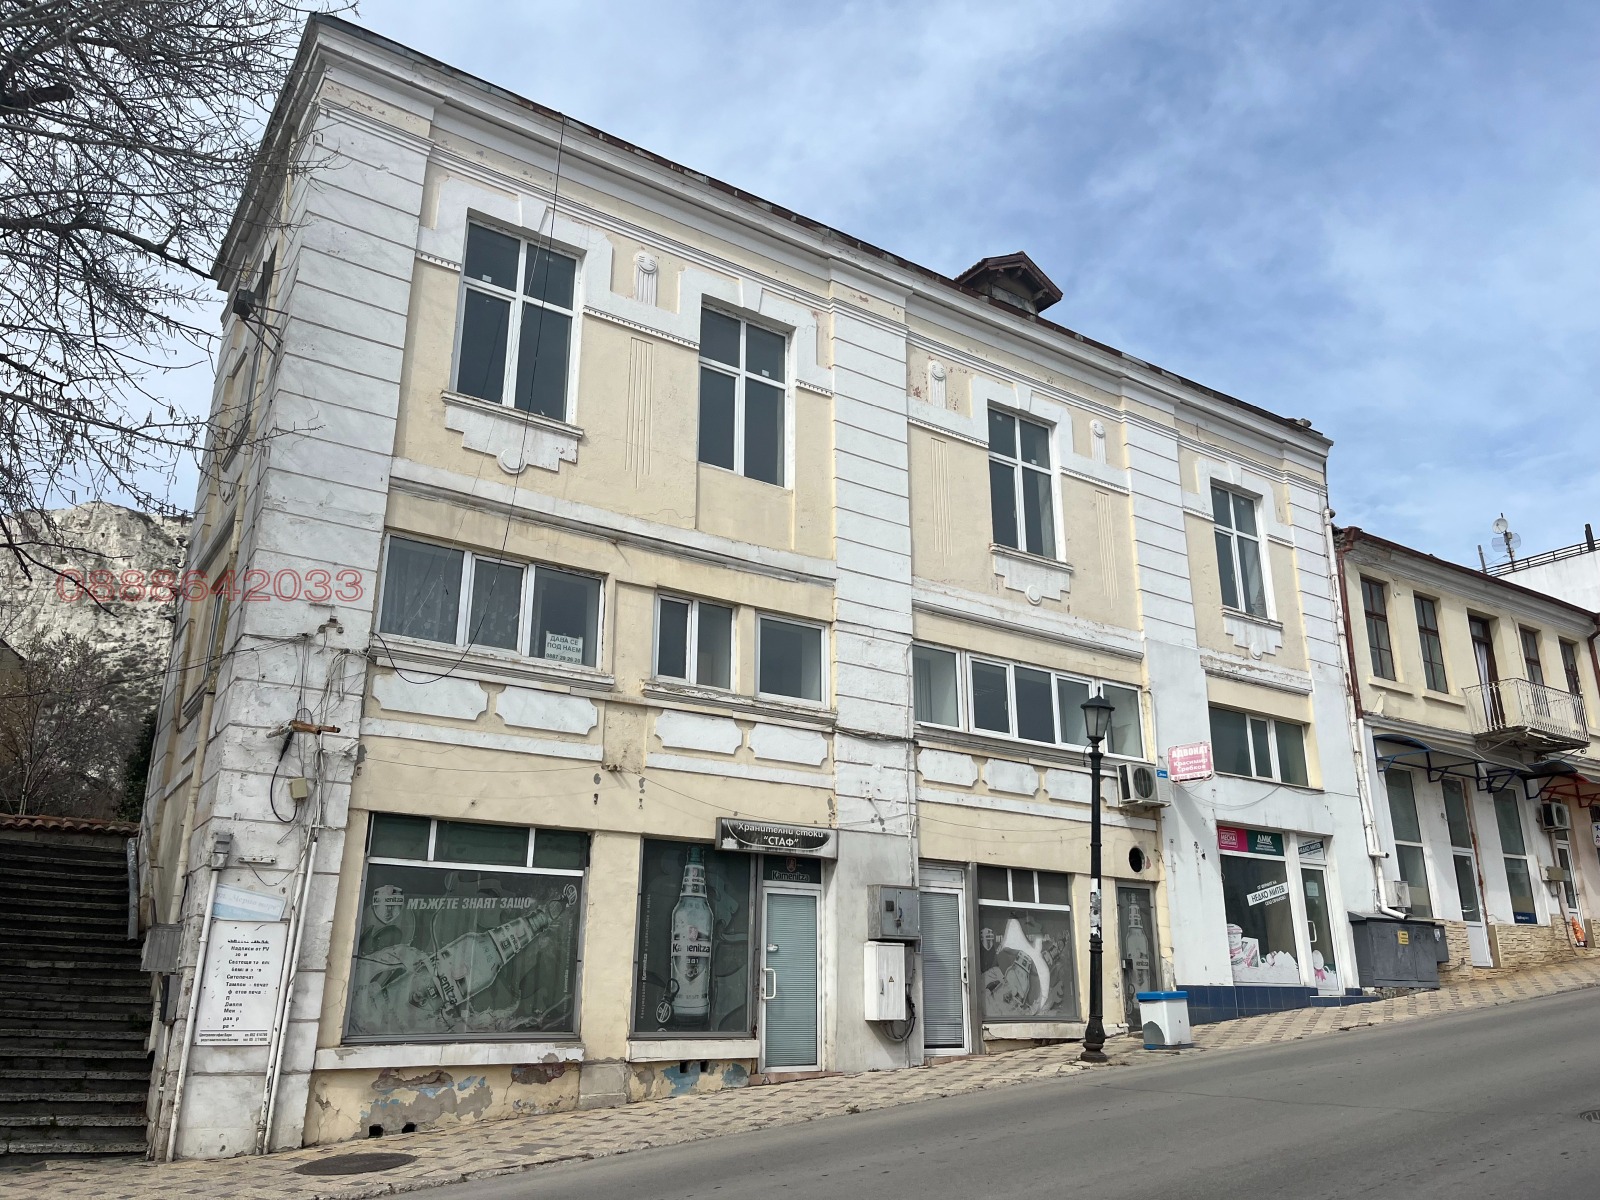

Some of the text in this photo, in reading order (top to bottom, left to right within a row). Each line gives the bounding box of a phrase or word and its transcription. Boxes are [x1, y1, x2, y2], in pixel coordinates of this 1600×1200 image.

[550, 635, 569, 644] ДАВА
[547, 642, 581, 653] ПОД НАЕМ
[1172, 745, 1208, 758] АДВОКАТ
[1174, 758, 1208, 767] Красимир
[738, 822, 824, 838] Хранителни стоки
[771, 870, 810, 882] Kamenitza
[407, 897, 532, 910] МЪЖЕТЕ ЗНАЯТ ЗАЩО
